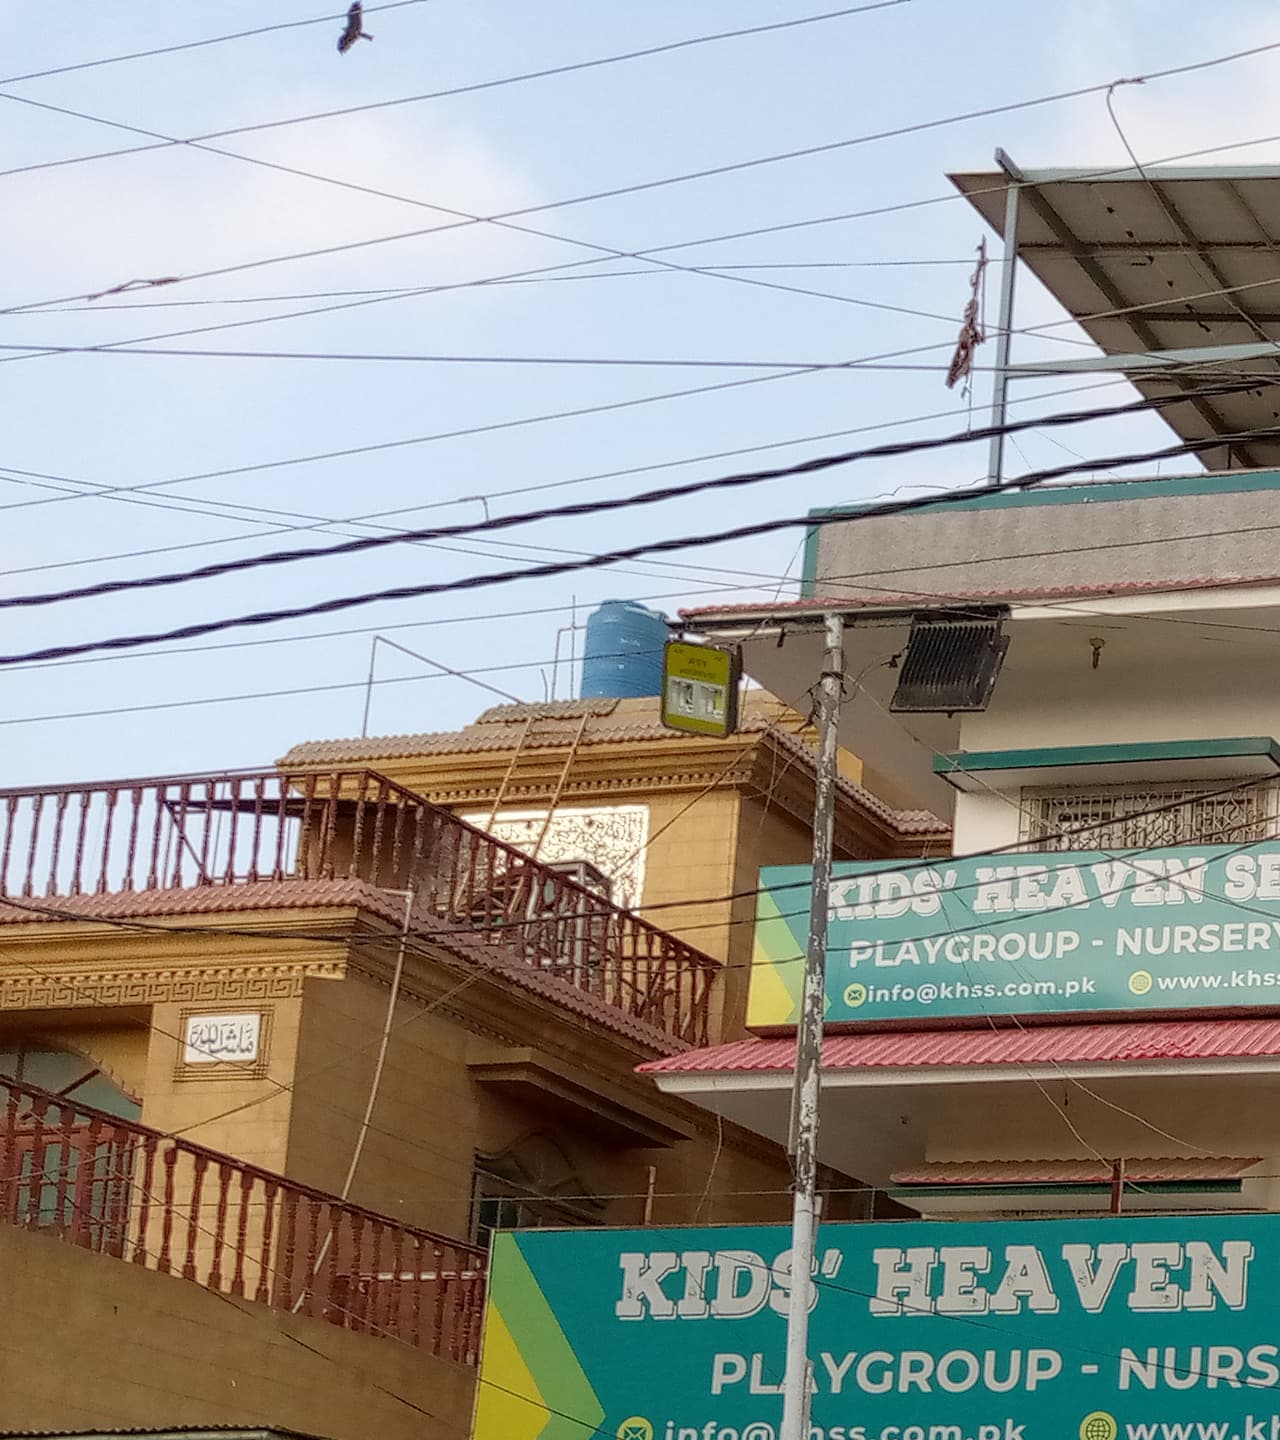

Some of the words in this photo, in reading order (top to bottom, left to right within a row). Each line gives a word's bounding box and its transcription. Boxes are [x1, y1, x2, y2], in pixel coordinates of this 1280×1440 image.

[973, 856, 1209, 915] HEAVEN
[849, 929, 1079, 968] PLAYGROUP
[867, 975, 1097, 1003] info@khss.com.pk
[615, 1248, 843, 1320] KIDS'
[869, 1240, 1255, 1317] HEAVEN
